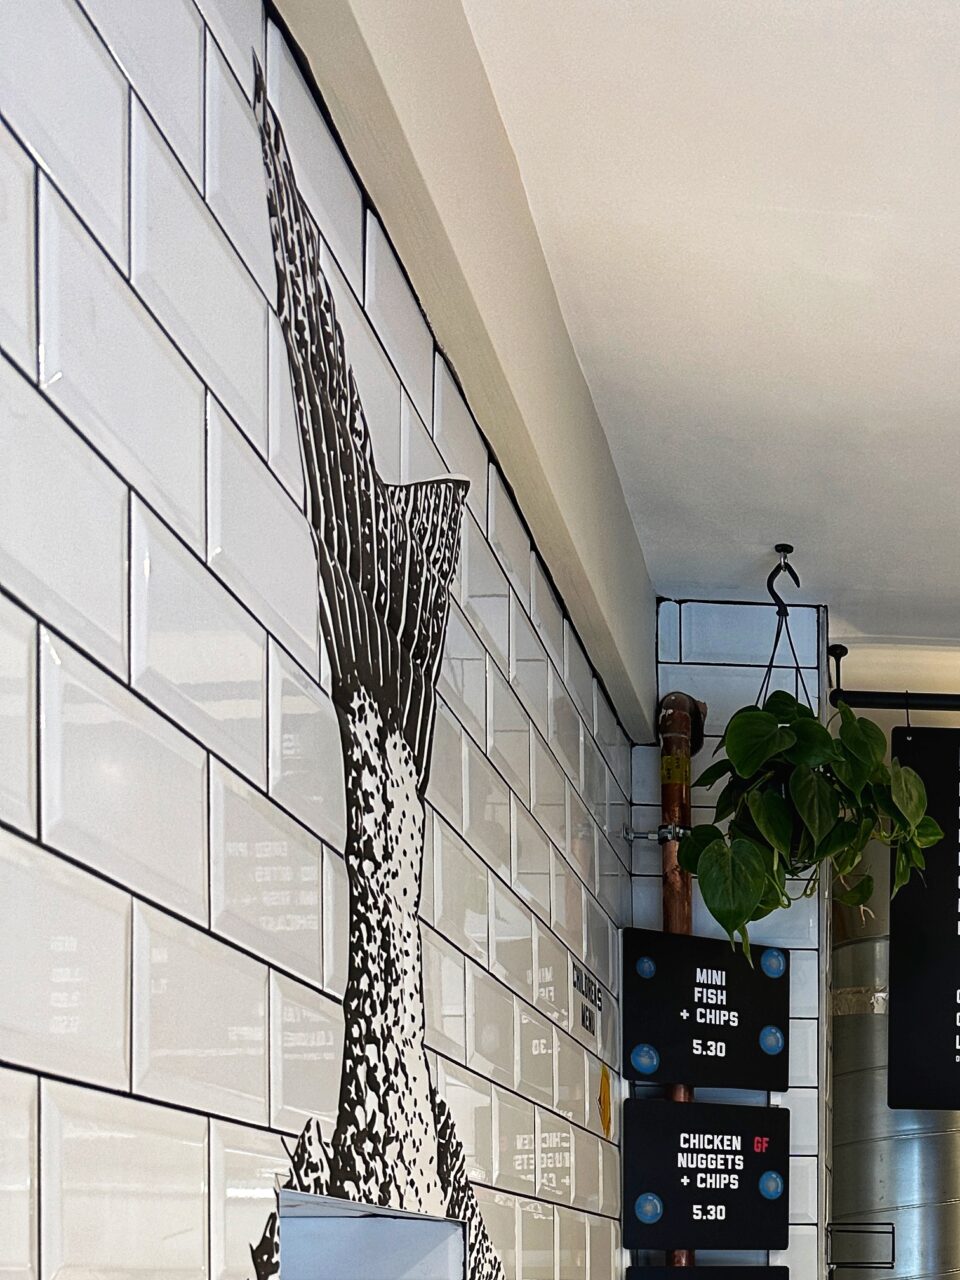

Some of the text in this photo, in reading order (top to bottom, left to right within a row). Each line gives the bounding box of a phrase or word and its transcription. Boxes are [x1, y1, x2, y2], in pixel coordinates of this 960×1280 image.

[696, 968, 725, 986] MINI
[695, 987, 726, 1005] FISH
[680, 1008, 738, 1026] + CHIPS
[693, 1039, 725, 1057] 5.30
[680, 1133, 768, 1152] CHICKEN GF
[678, 1153, 743, 1169] NUGGETS
[681, 1173, 738, 1189] + CHIPS
[693, 1205, 725, 1220] 5.30
